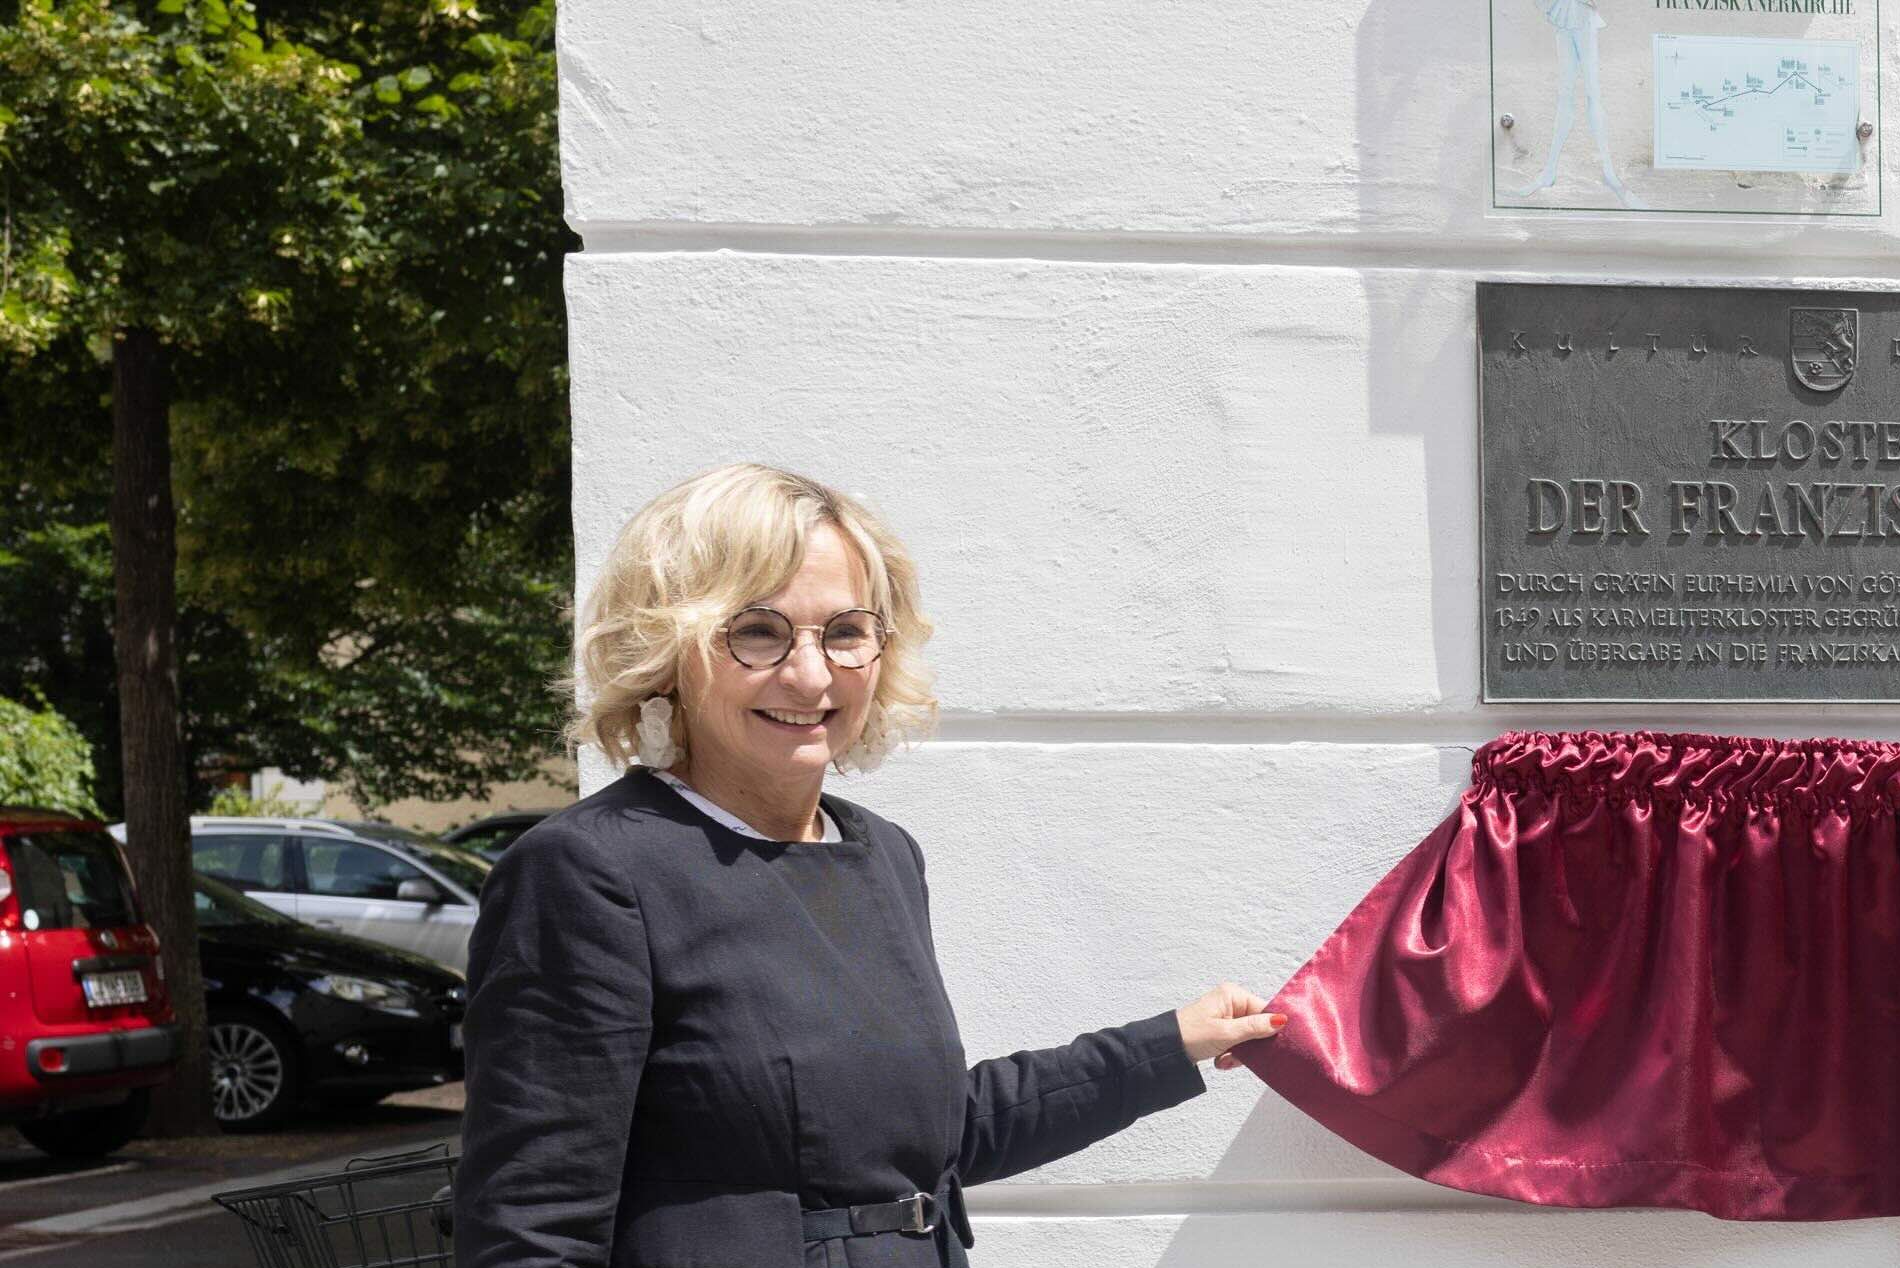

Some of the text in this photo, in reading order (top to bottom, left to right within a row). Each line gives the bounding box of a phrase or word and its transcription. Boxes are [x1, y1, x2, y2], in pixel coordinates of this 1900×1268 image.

[1510, 330, 1758, 357] KULTUR
[1526, 478, 1650, 535] DER
[1497, 573, 1584, 592] DURCH
[1593, 571, 1676, 594] GRÄFIN
[1685, 573, 1799, 593] EUPHEMIA
[1803, 574, 1854, 594] VON
[1495, 607, 1542, 630] 1349
[1545, 607, 1583, 627] ALS
[1590, 607, 1822, 631] KARMELITERKLOSTER
[1504, 641, 1559, 662] UND
[1567, 637, 1682, 662] ÜBERGABE
[1689, 642, 1722, 662] AN
[1731, 643, 1768, 662] DIE
